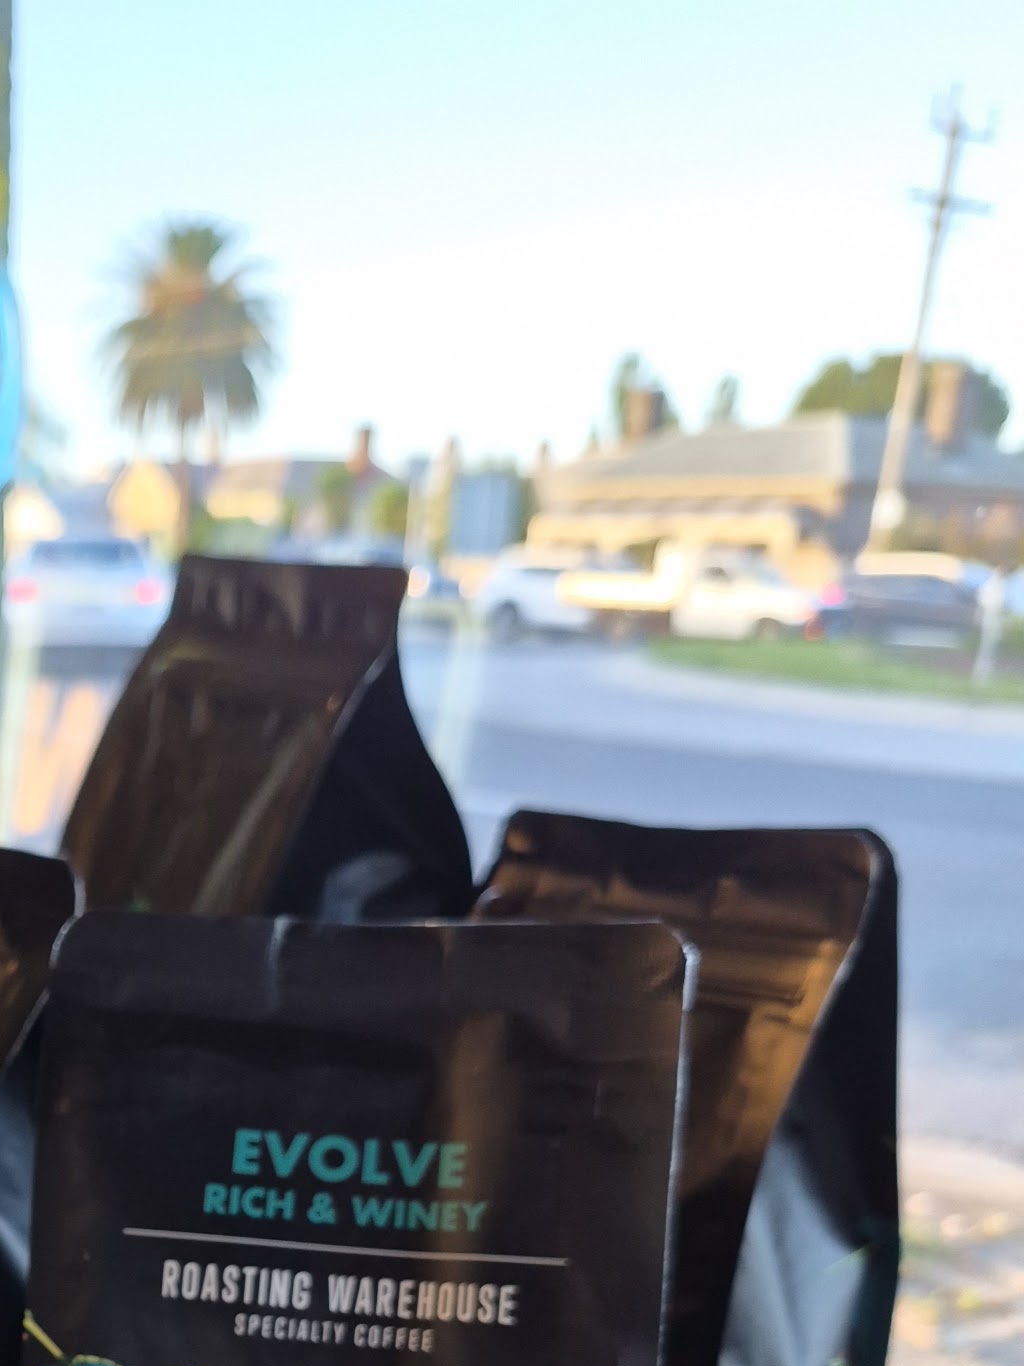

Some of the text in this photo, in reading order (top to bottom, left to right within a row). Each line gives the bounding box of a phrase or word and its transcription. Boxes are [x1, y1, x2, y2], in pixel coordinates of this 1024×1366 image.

[232, 1127, 469, 1188] EVOLVE
[203, 1182, 487, 1233] RICH & WINEY
[161, 1258, 520, 1326] ROASTING WAREHOUSE
[234, 1313, 435, 1353] SPECIALTY COFFEE
